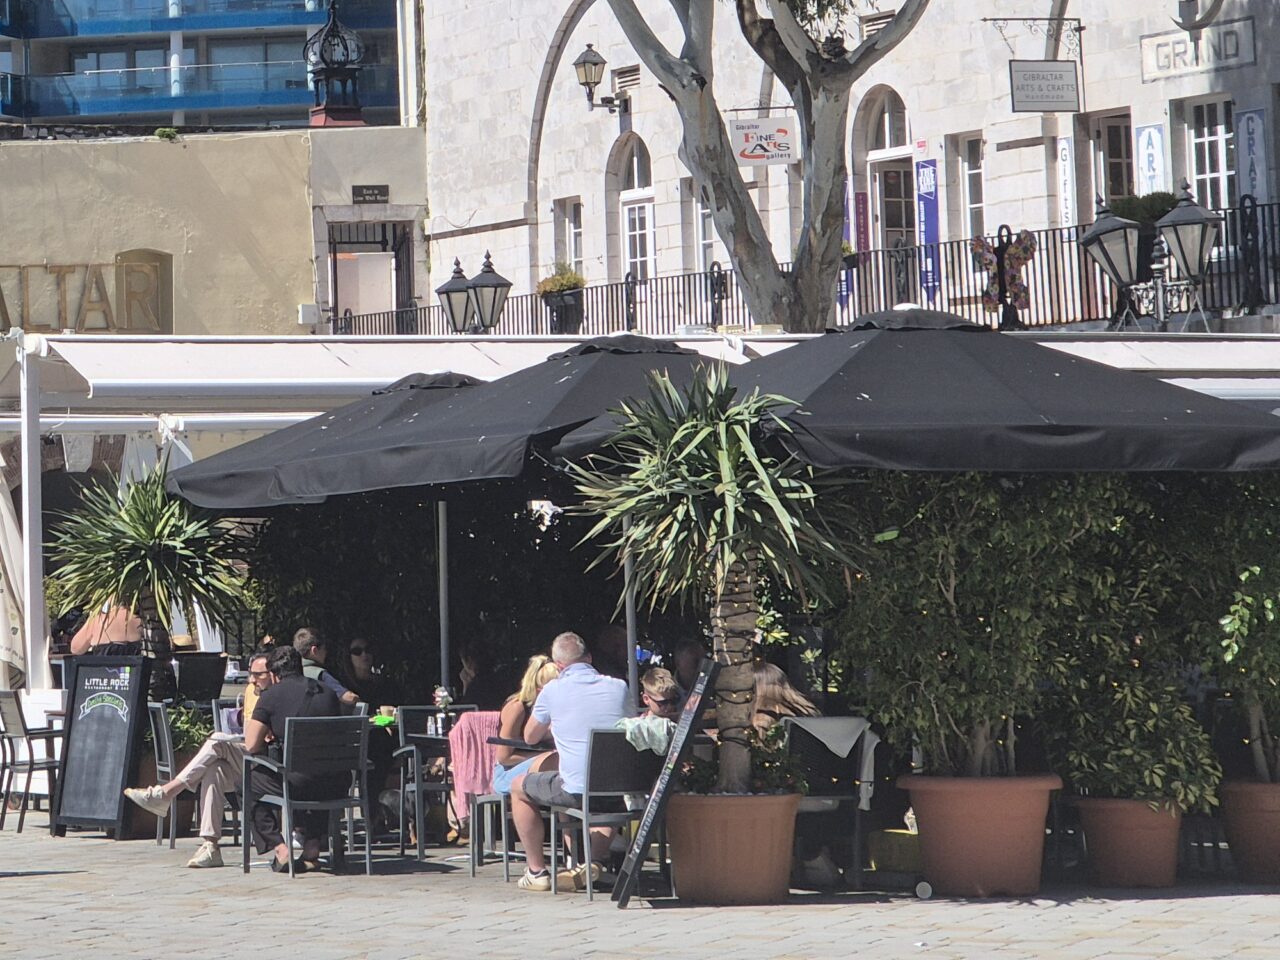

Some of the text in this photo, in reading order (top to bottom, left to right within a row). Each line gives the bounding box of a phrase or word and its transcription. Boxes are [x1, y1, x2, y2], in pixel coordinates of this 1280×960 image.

[1156, 29, 1239, 71] GRND
[1023, 73, 1064, 81] GIBRALTAR
[1016, 83, 1075, 92] ARTS & CRAFTS
[85, 678, 130, 686] LITTLE ROCK
